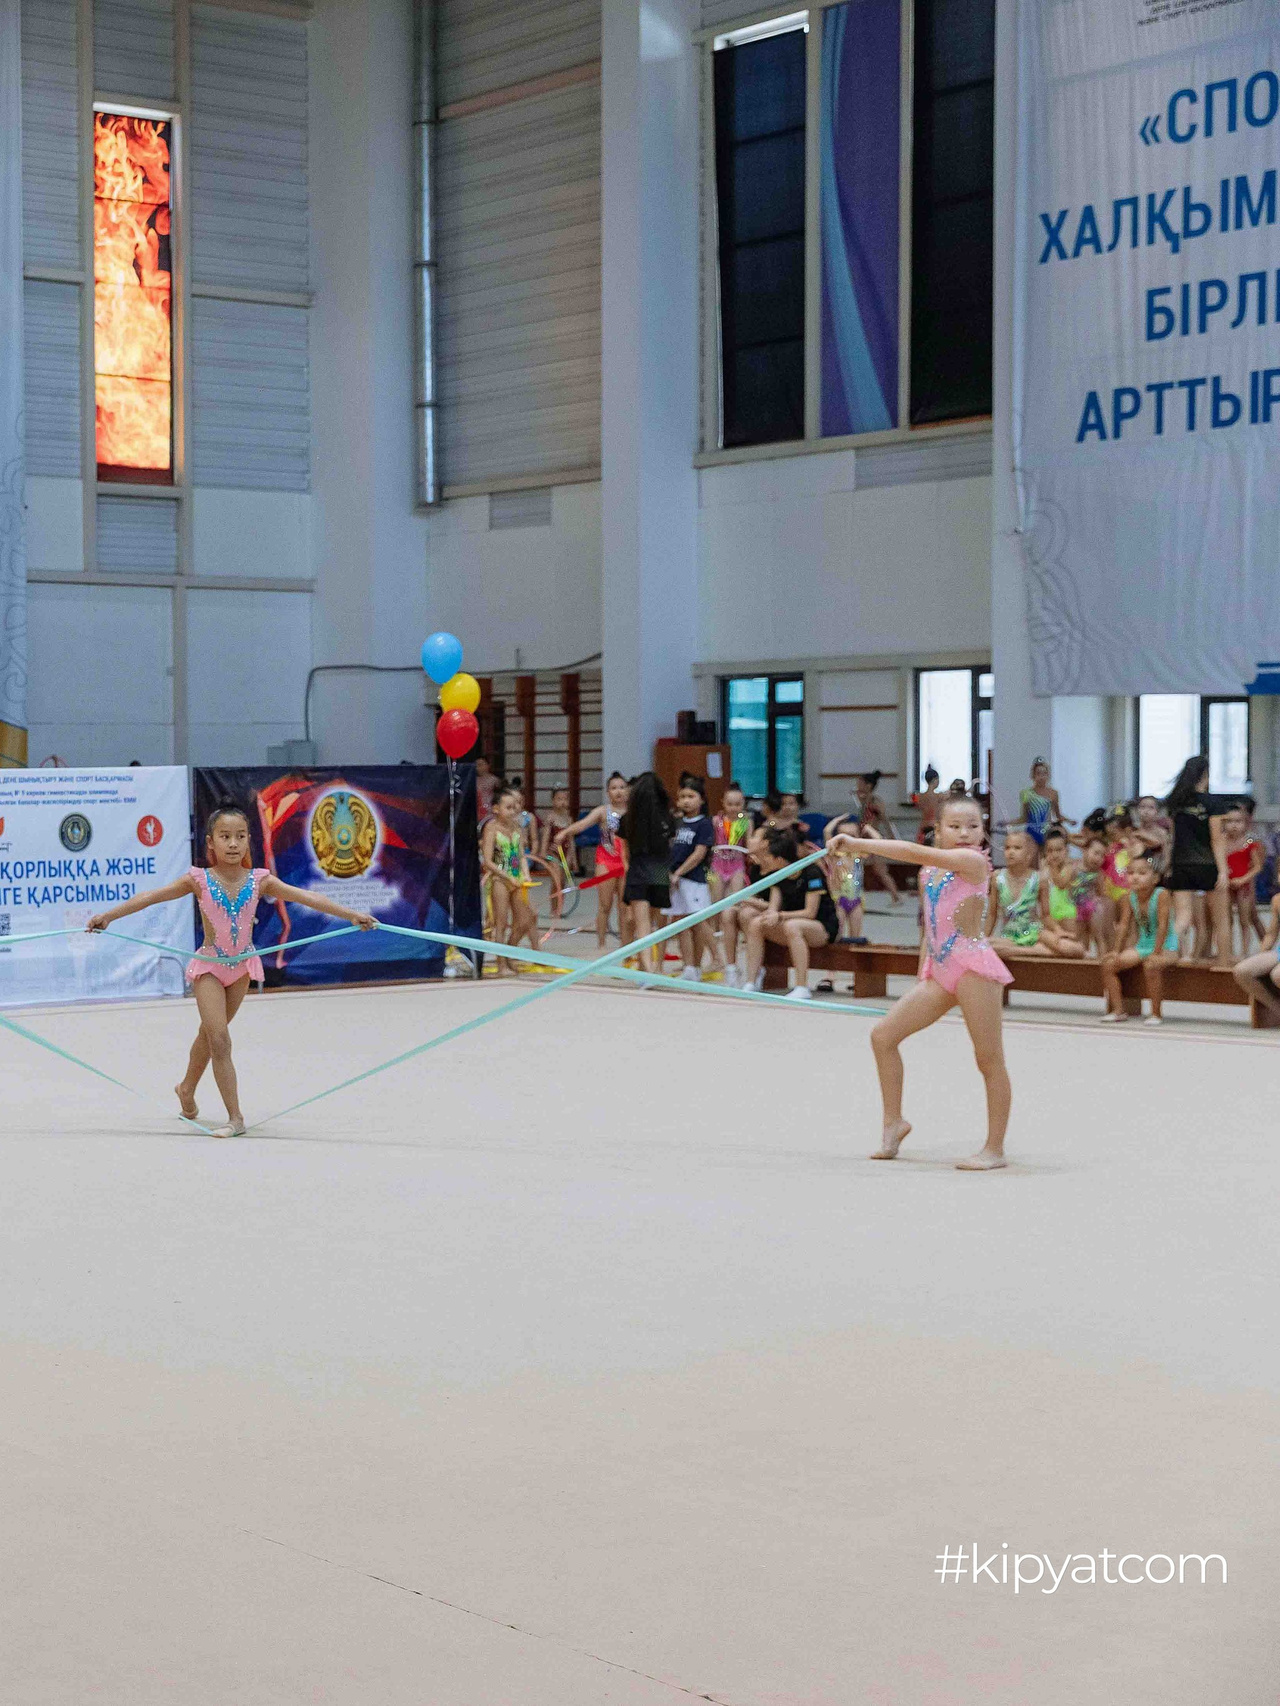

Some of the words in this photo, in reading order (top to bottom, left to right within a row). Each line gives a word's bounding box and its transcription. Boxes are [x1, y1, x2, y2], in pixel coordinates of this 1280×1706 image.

[1139, 70, 1280, 147] «СПО
[1038, 169, 1277, 265] ХАЛҚЫМ
[106, 857, 157, 877] ЖӘНЕ
[26, 882, 136, 909] ҚАРСЫМЫЗ!
